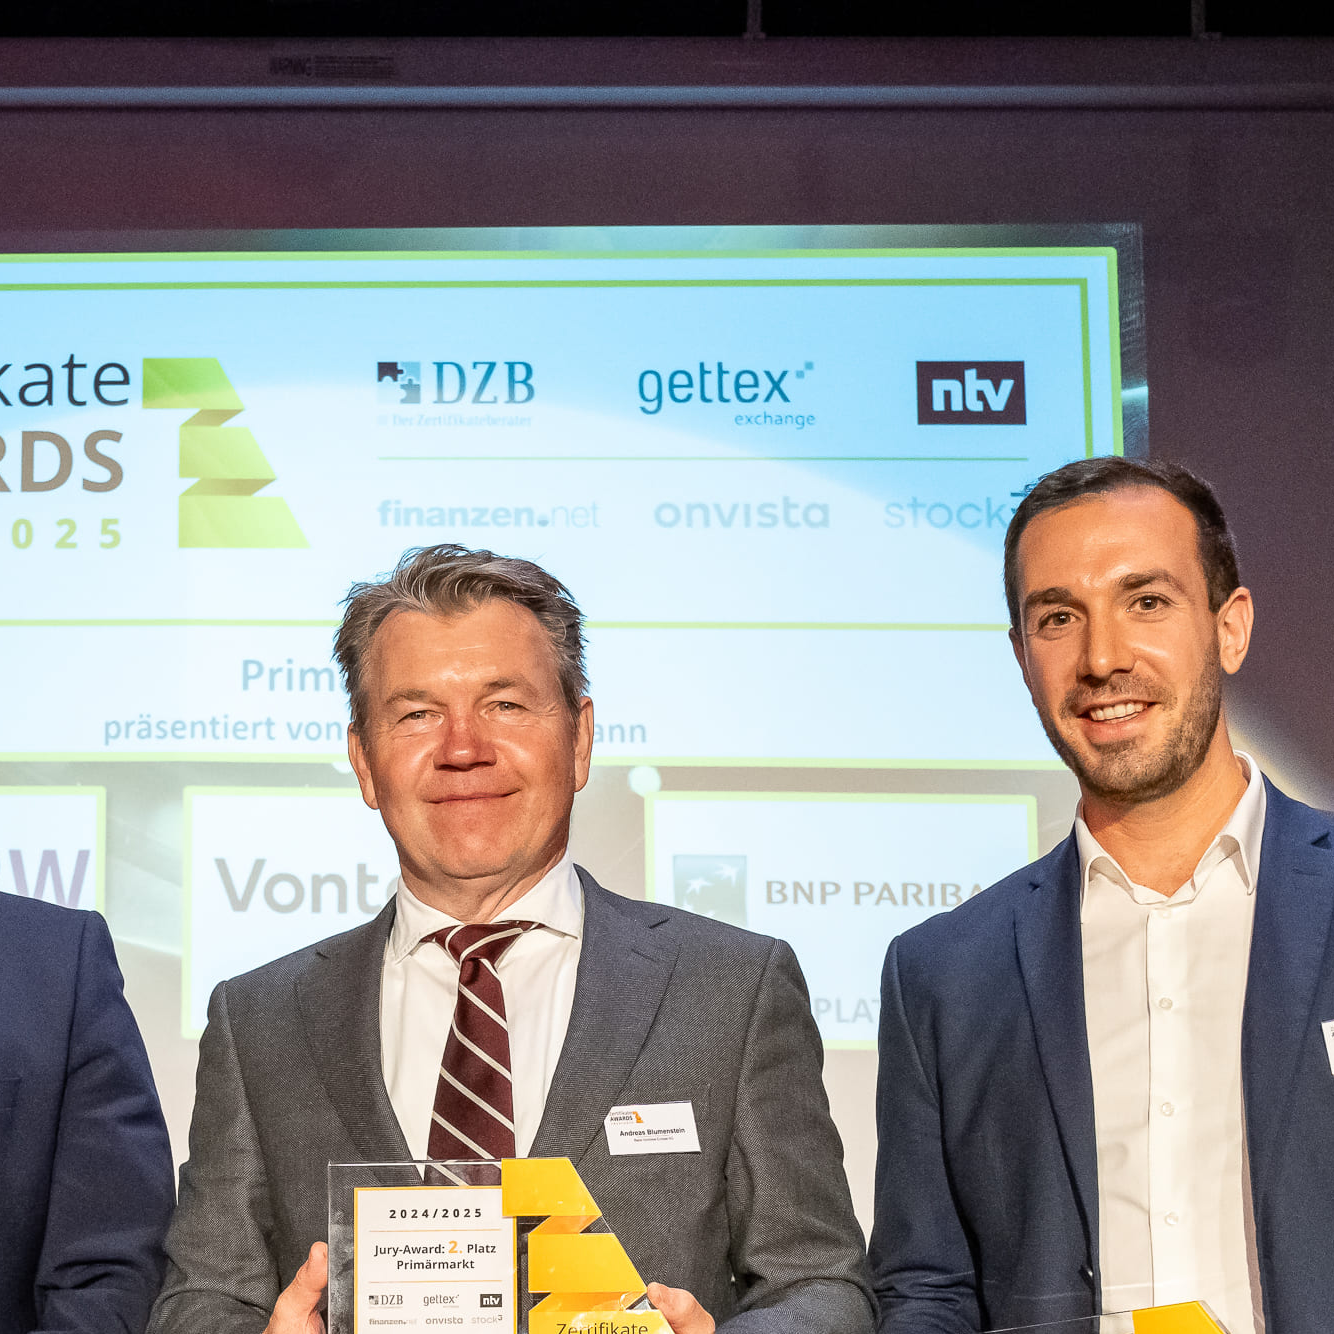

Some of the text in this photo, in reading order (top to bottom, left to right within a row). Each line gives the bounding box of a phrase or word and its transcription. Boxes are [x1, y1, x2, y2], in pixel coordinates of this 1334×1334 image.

[432, 361, 536, 404] DZB
[638, 361, 791, 415] gettex
[931, 368, 1015, 413] ntv
[734, 411, 816, 429] exchange
[378, 498, 602, 528] finanzen.net
[654, 495, 831, 529] onvista
[241, 658, 347, 692] Prim
[104, 714, 276, 746] präsentiert
[286, 721, 343, 741] von
[765, 880, 841, 905] BNP
[620, 1127, 686, 1137] Andreas Blumenstein
[389, 1208, 482, 1219] 2024/2025
[374, 1240, 497, 1257] Jury-Award: 2. Platz
[397, 1259, 475, 1270] Primärmarkt
[380, 1294, 404, 1305] DZB
[482, 1296, 500, 1306] ntv
[425, 1317, 464, 1325] onvista
